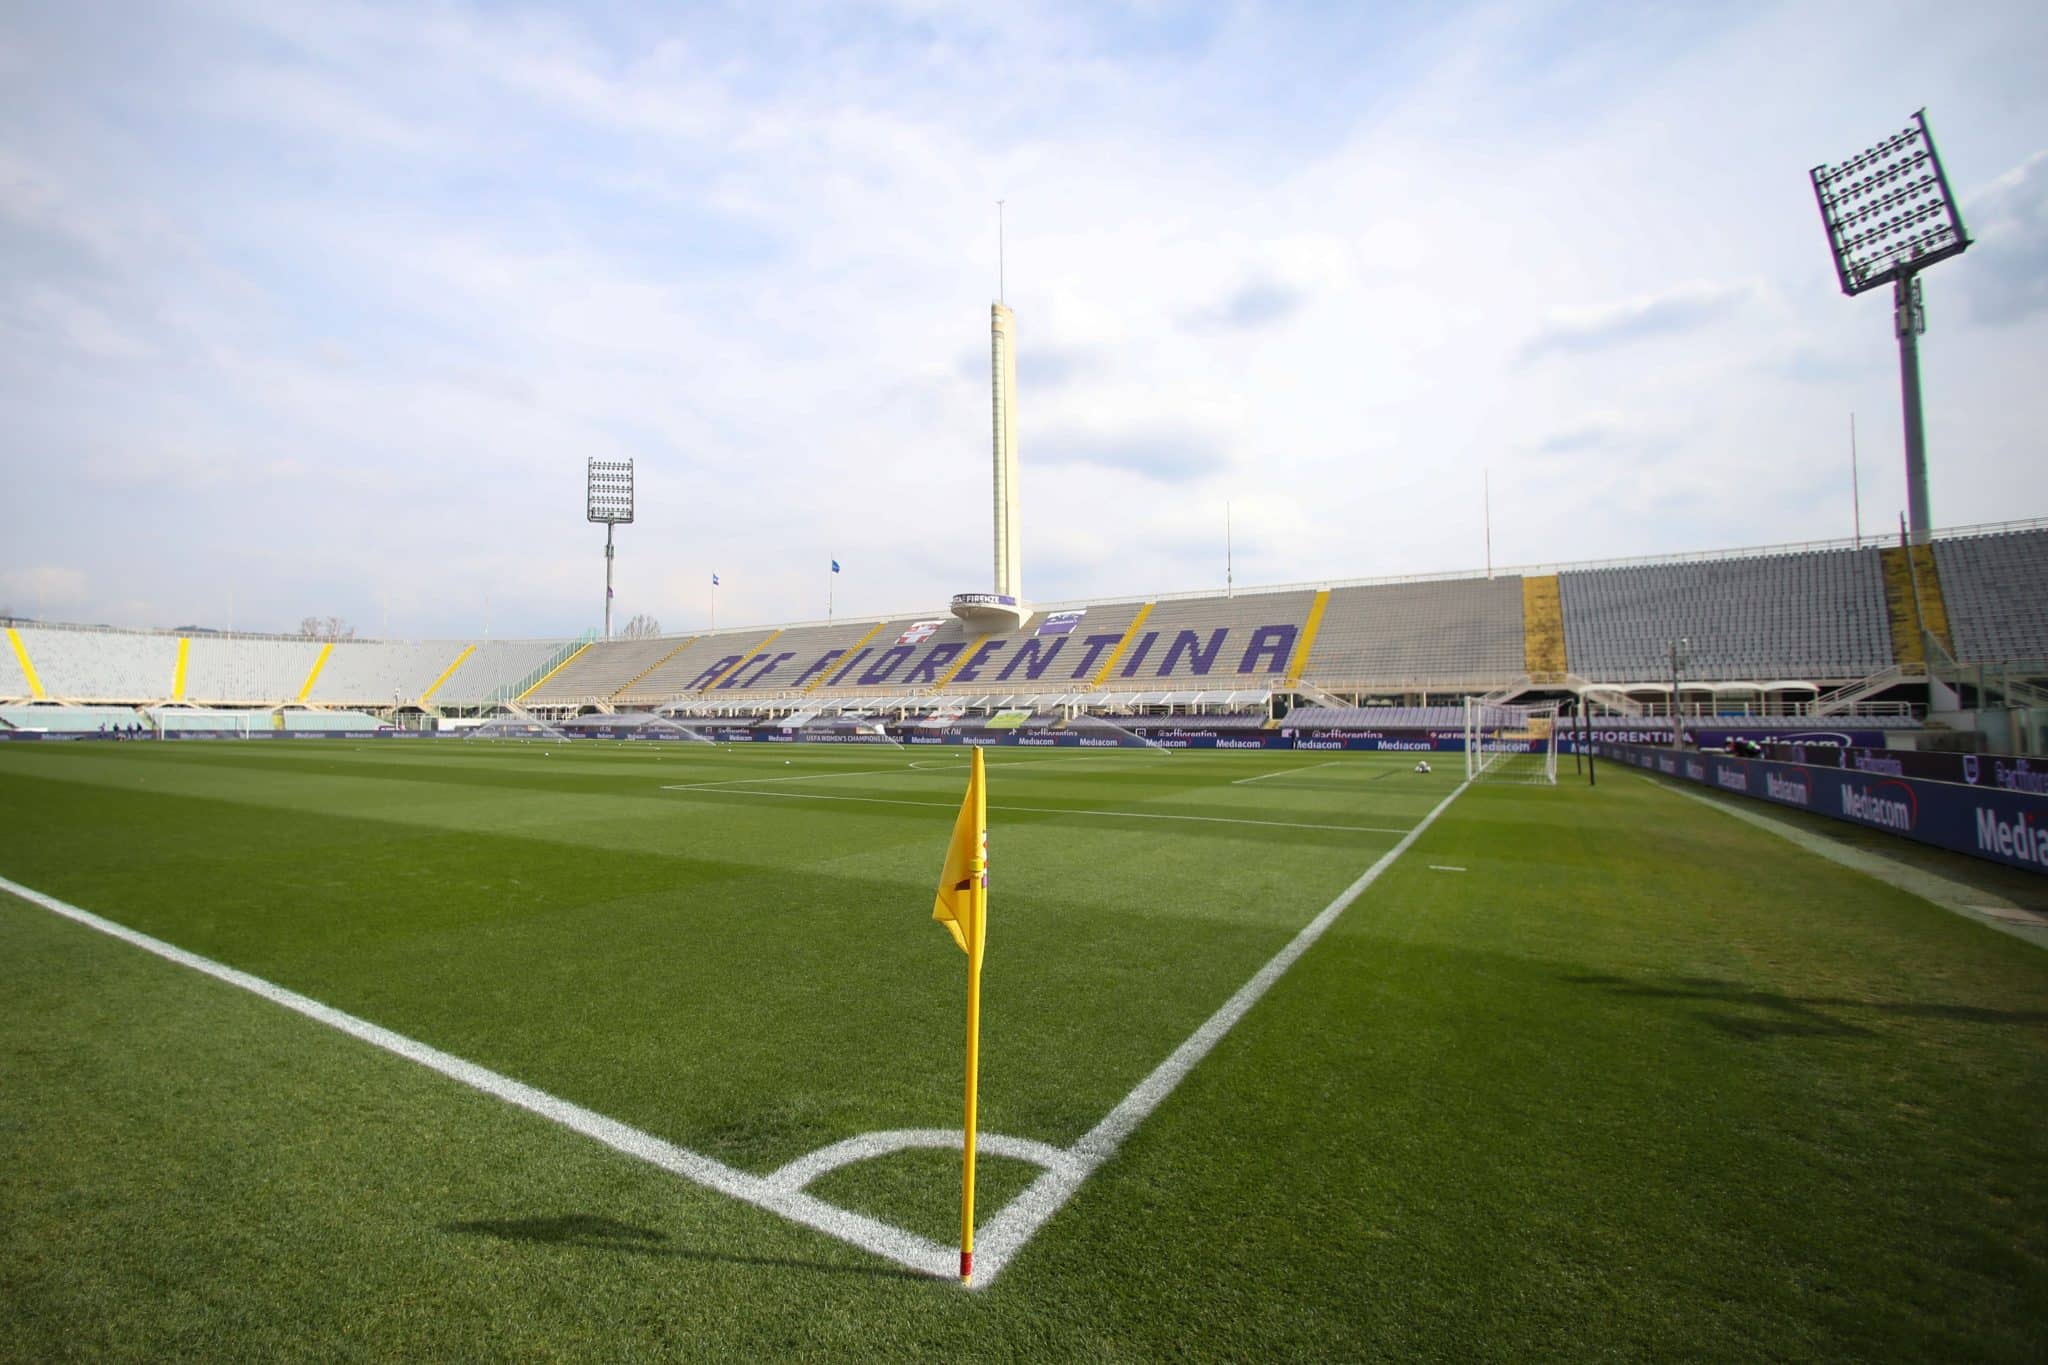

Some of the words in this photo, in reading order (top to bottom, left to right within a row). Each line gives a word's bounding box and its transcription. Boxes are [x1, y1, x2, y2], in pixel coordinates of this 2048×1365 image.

[684, 652, 797, 690] ACF
[790, 624, 1299, 687] FIORENTINA
[963, 736, 995, 745] Mediacom
[1019, 737, 1054, 746] Mediacom
[1080, 738, 1118, 746] Mediacom
[1146, 738, 1187, 748] Mediacom
[1216, 739, 1260, 748] Mediacom
[1378, 740, 1430, 751] Mediacom
[1841, 783, 1911, 831] Mediacom
